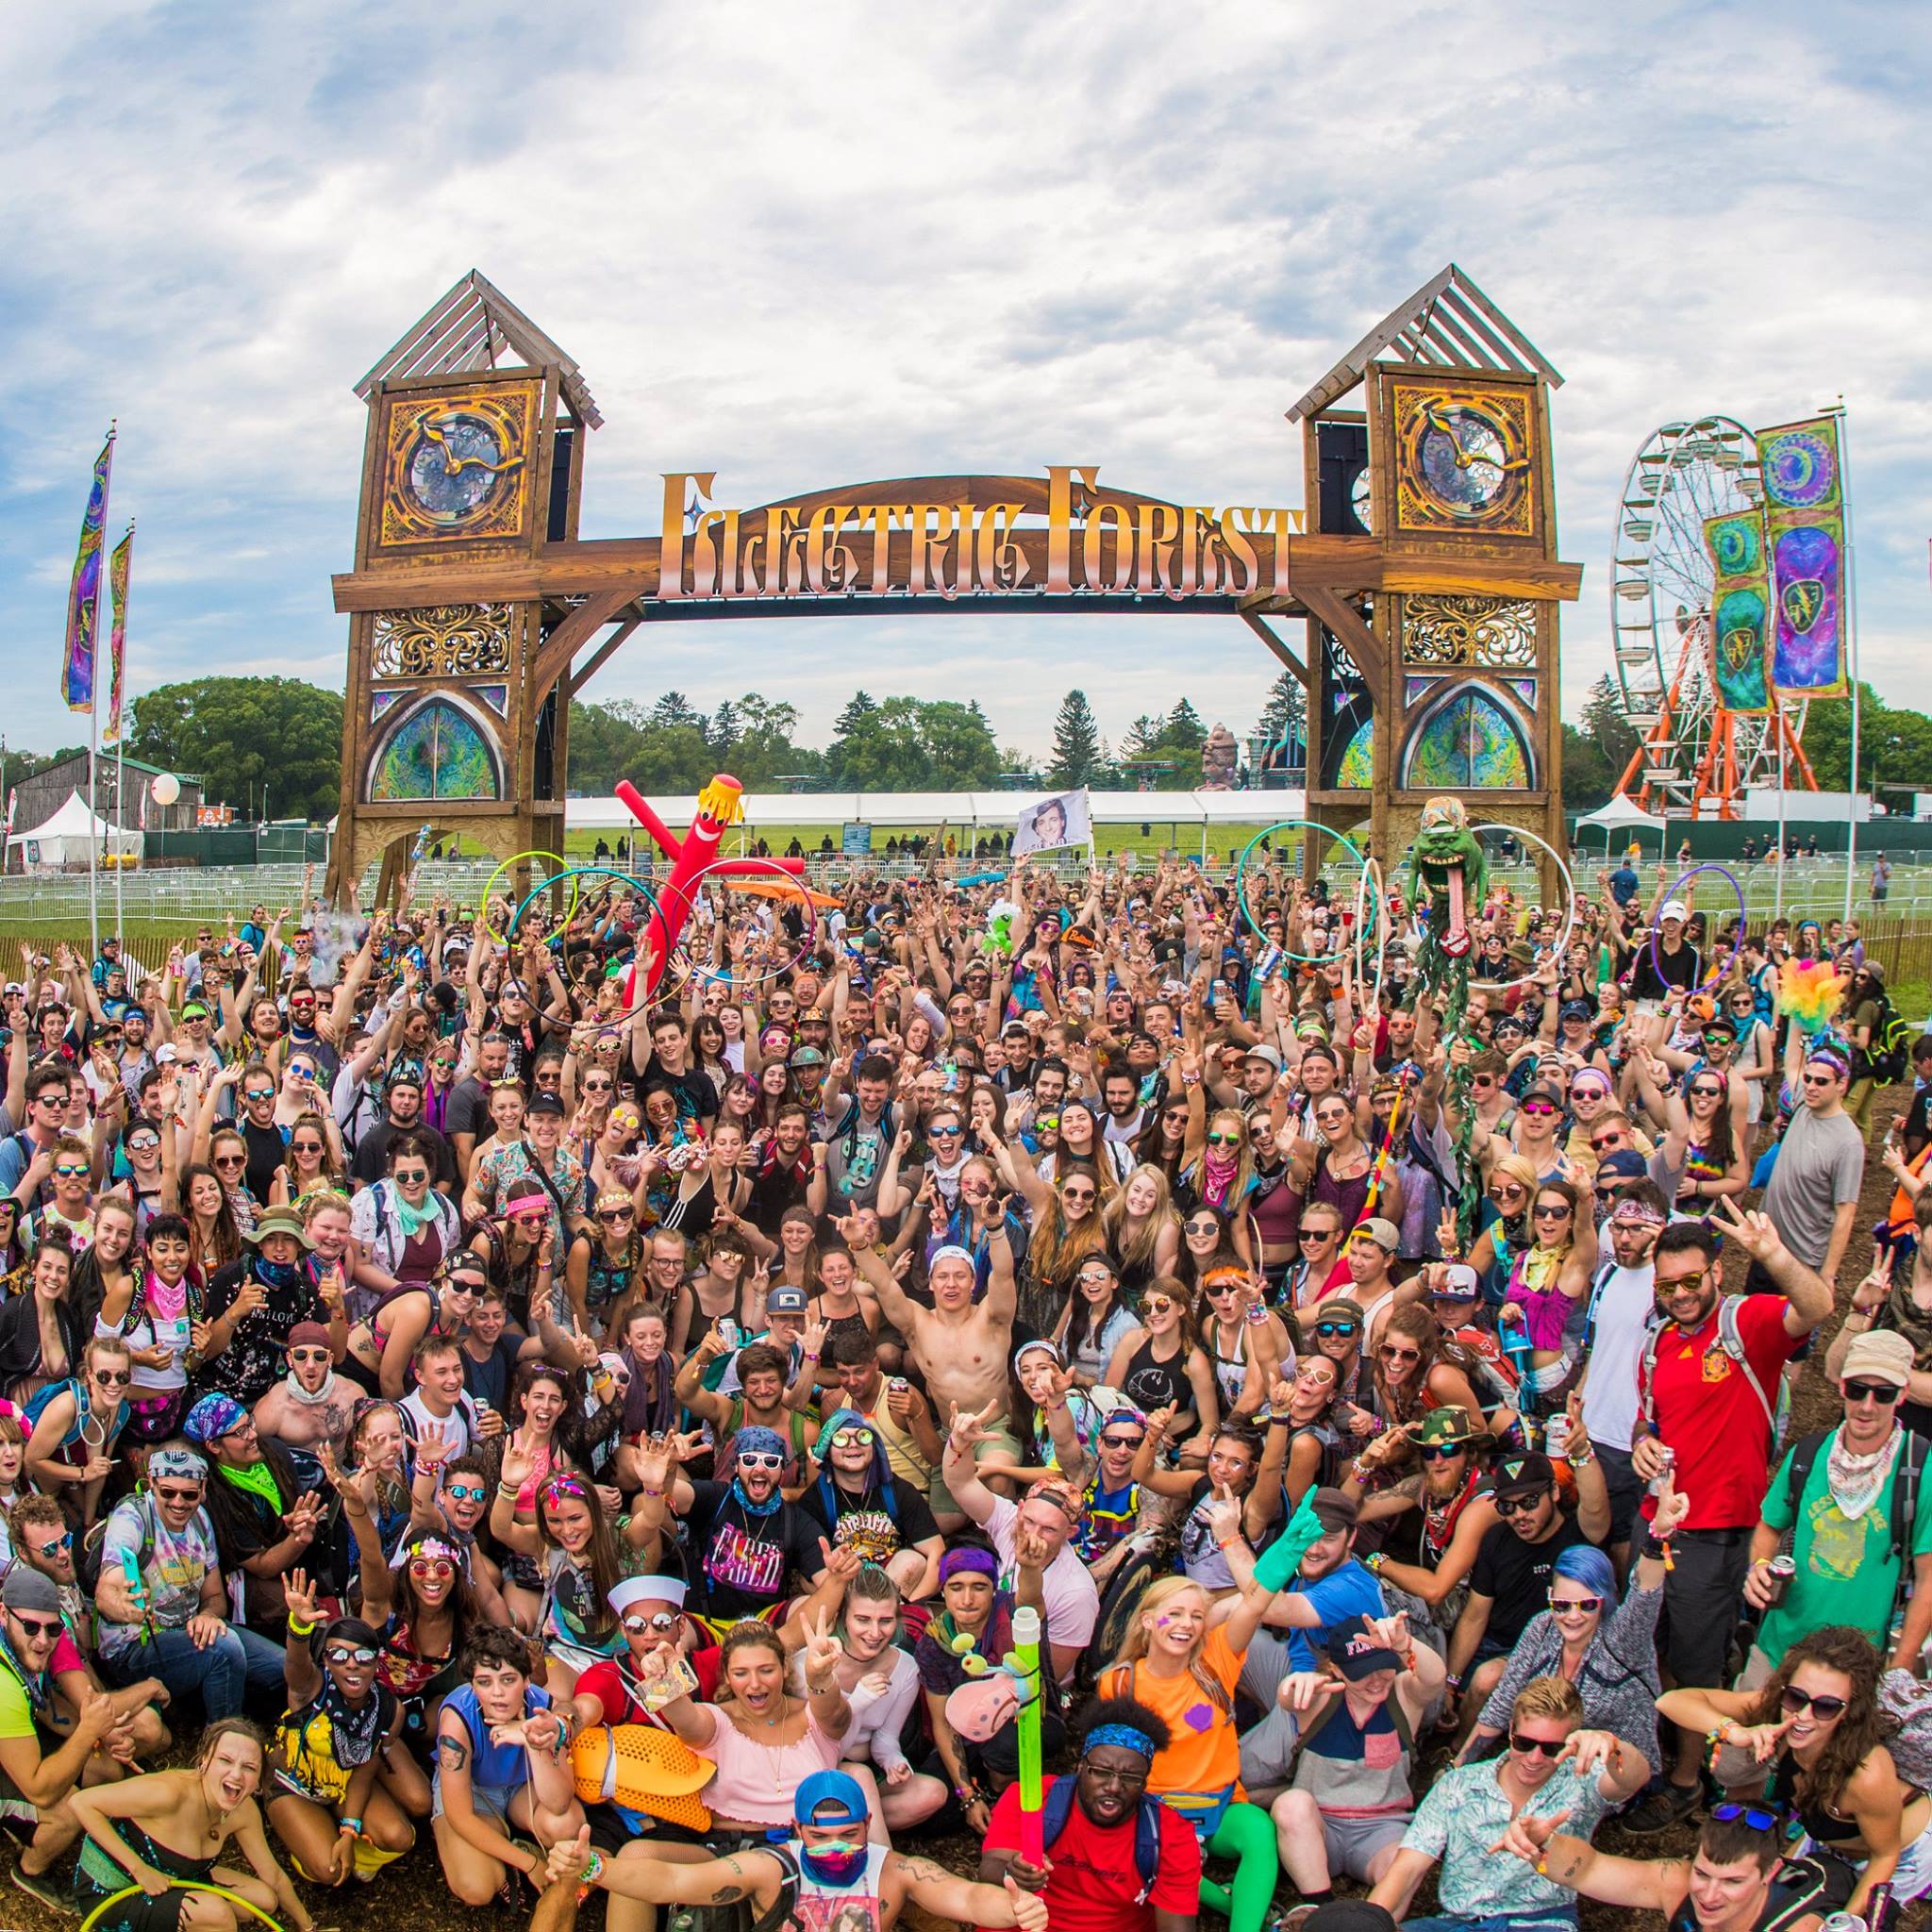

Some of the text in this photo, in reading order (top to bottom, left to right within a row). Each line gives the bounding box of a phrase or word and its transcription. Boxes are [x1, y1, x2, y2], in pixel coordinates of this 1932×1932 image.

[657, 465, 1307, 601] ELECTRIC FOREST
[1344, 1641, 1374, 1657] FD
